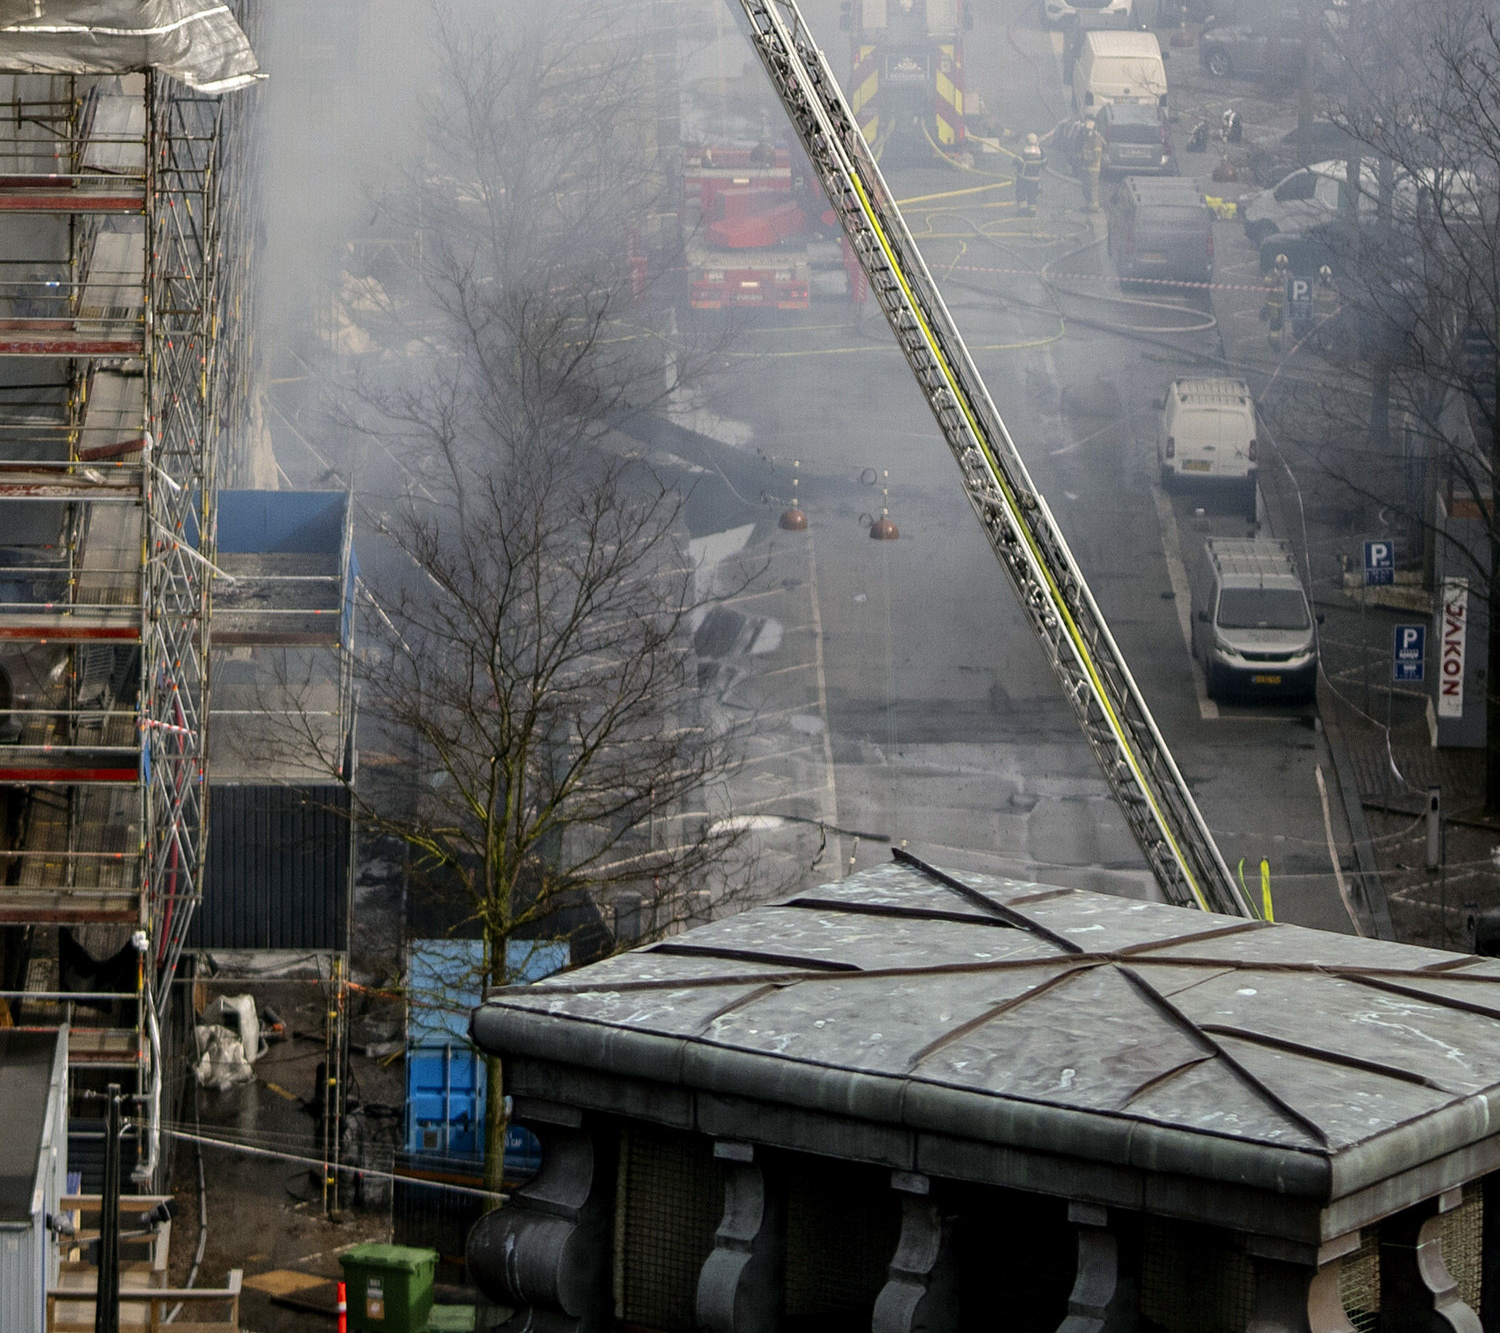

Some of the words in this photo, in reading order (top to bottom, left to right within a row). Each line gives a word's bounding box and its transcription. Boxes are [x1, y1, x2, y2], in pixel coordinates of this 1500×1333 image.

[1293, 280, 1308, 300] P
[1371, 543, 1388, 567] P
[1403, 628, 1418, 648] P
